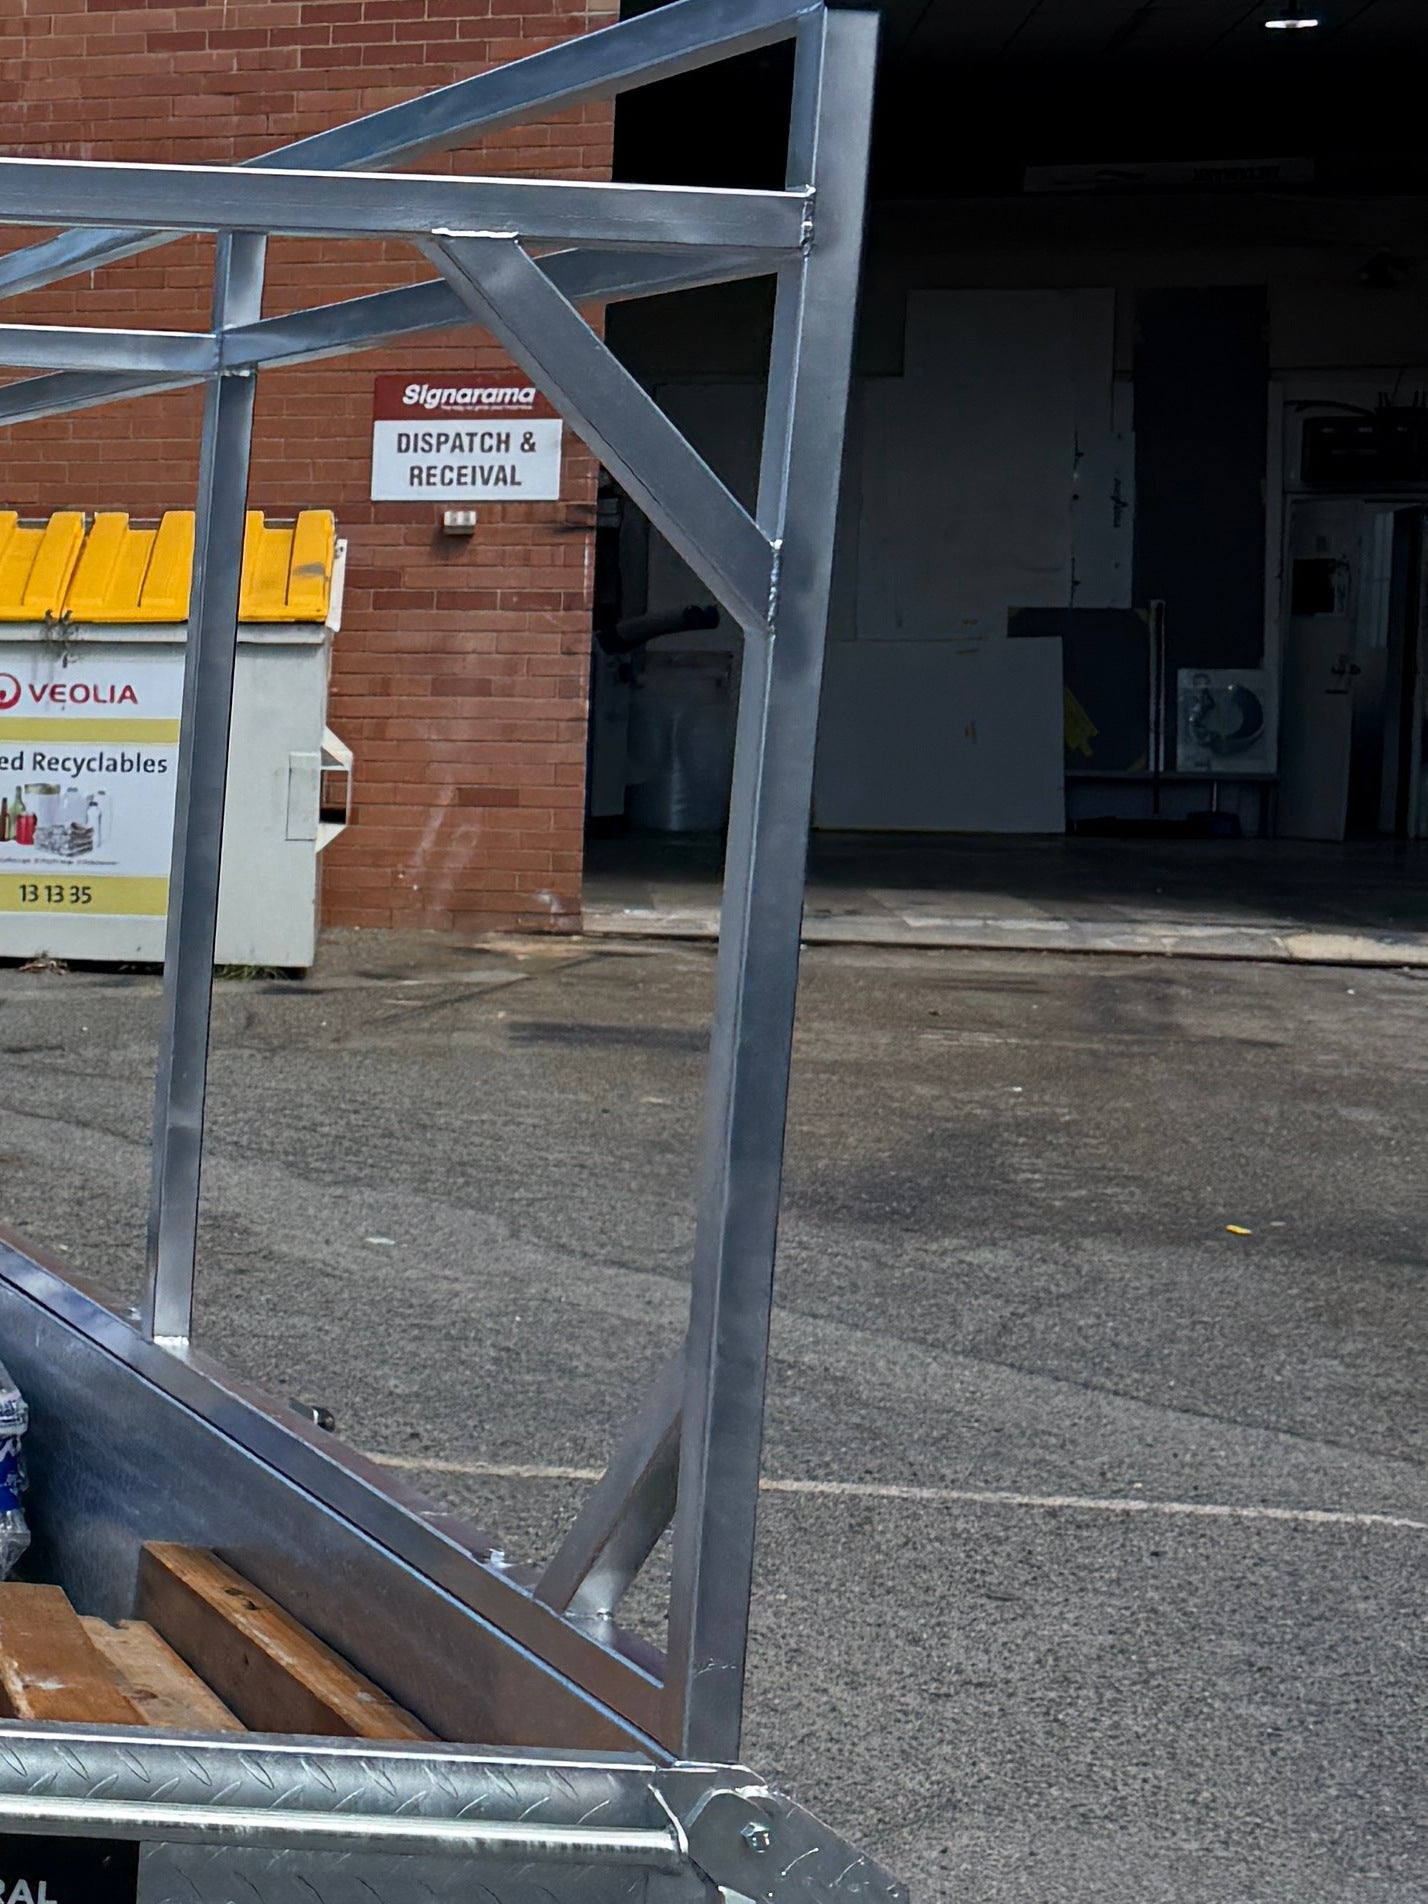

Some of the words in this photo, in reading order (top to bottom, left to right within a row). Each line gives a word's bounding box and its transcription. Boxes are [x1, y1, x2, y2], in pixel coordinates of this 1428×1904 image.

[402, 384, 536, 409] Signarama
[397, 432, 511, 453] DISPATCH
[520, 431, 536, 453] &
[409, 465, 522, 486] RECEIVAL
[29, 683, 138, 705] VEOLIA
[33, 752, 168, 778] Recyclables
[19, 884, 39, 903] 13
[44, 885, 64, 904] 13
[70, 885, 92, 905] 35
